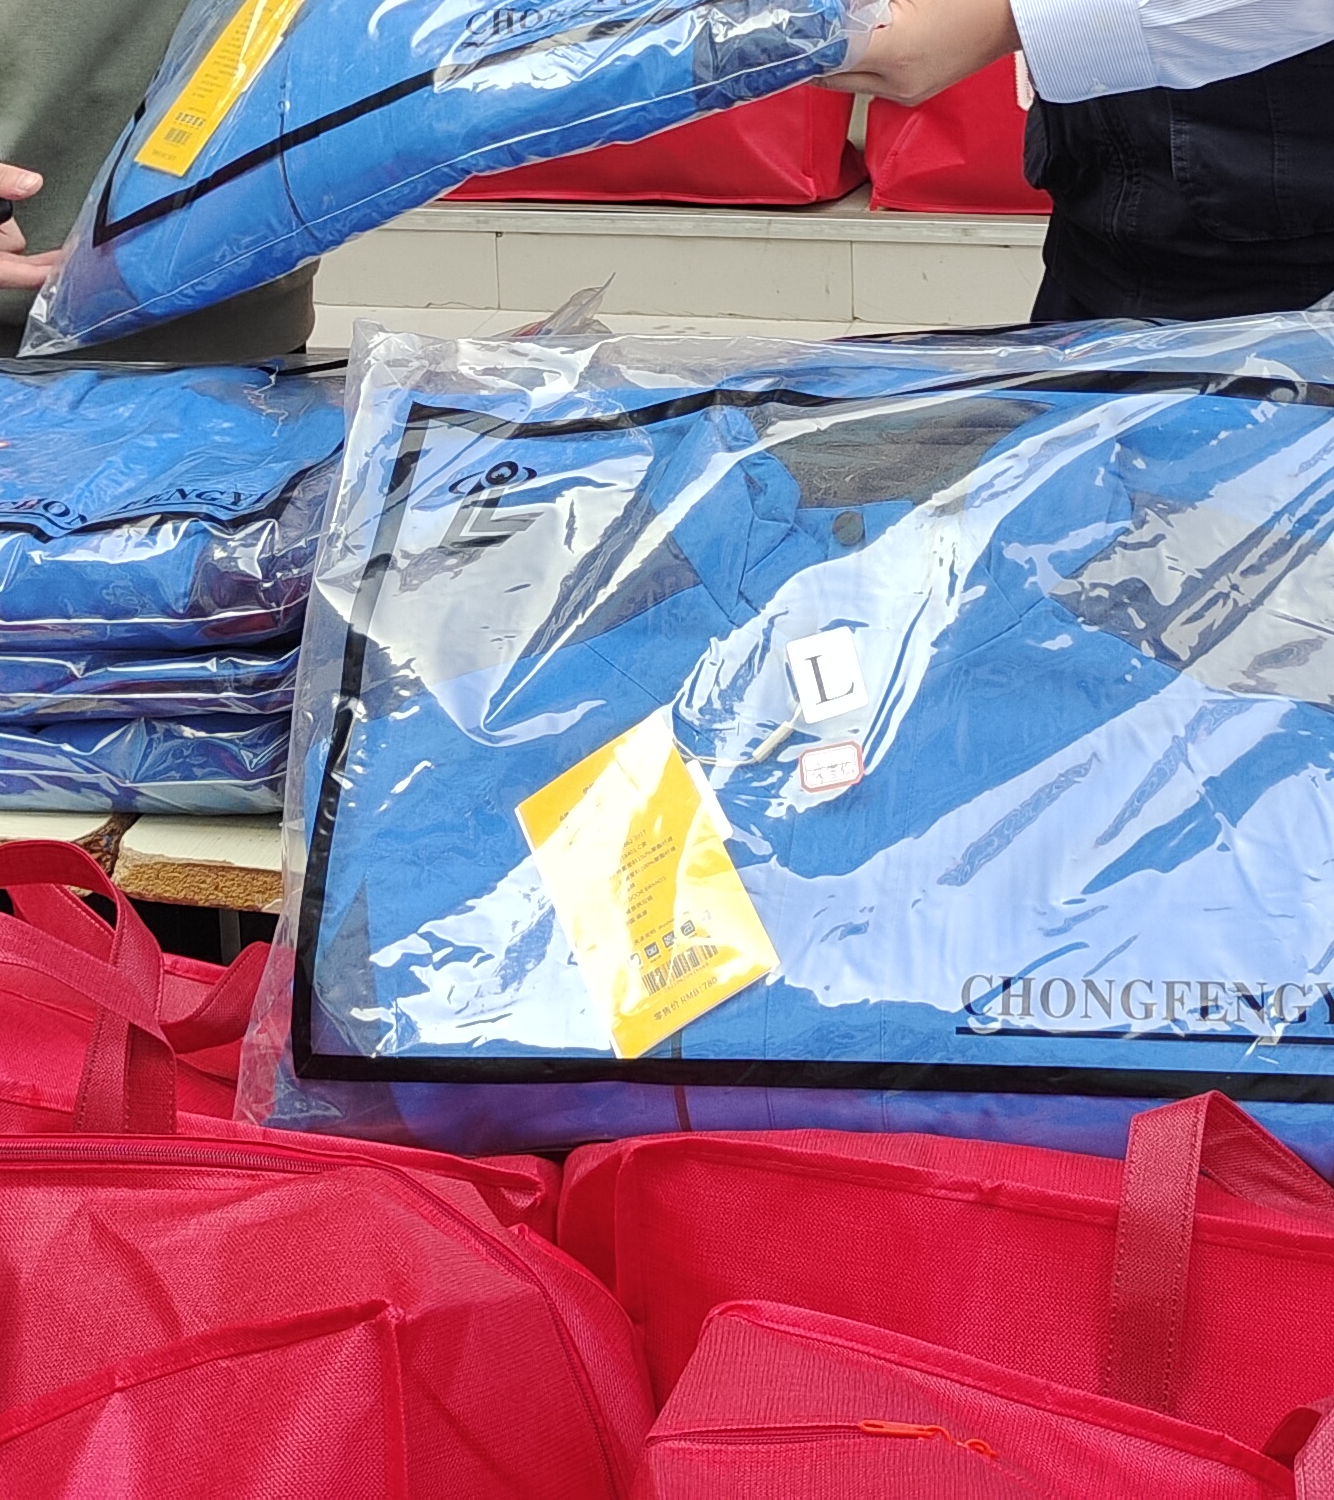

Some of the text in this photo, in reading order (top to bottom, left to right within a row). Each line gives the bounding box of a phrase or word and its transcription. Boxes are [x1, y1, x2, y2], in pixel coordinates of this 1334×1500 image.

[804, 654, 855, 705] L
[653, 1000, 679, 1021] 零售价
